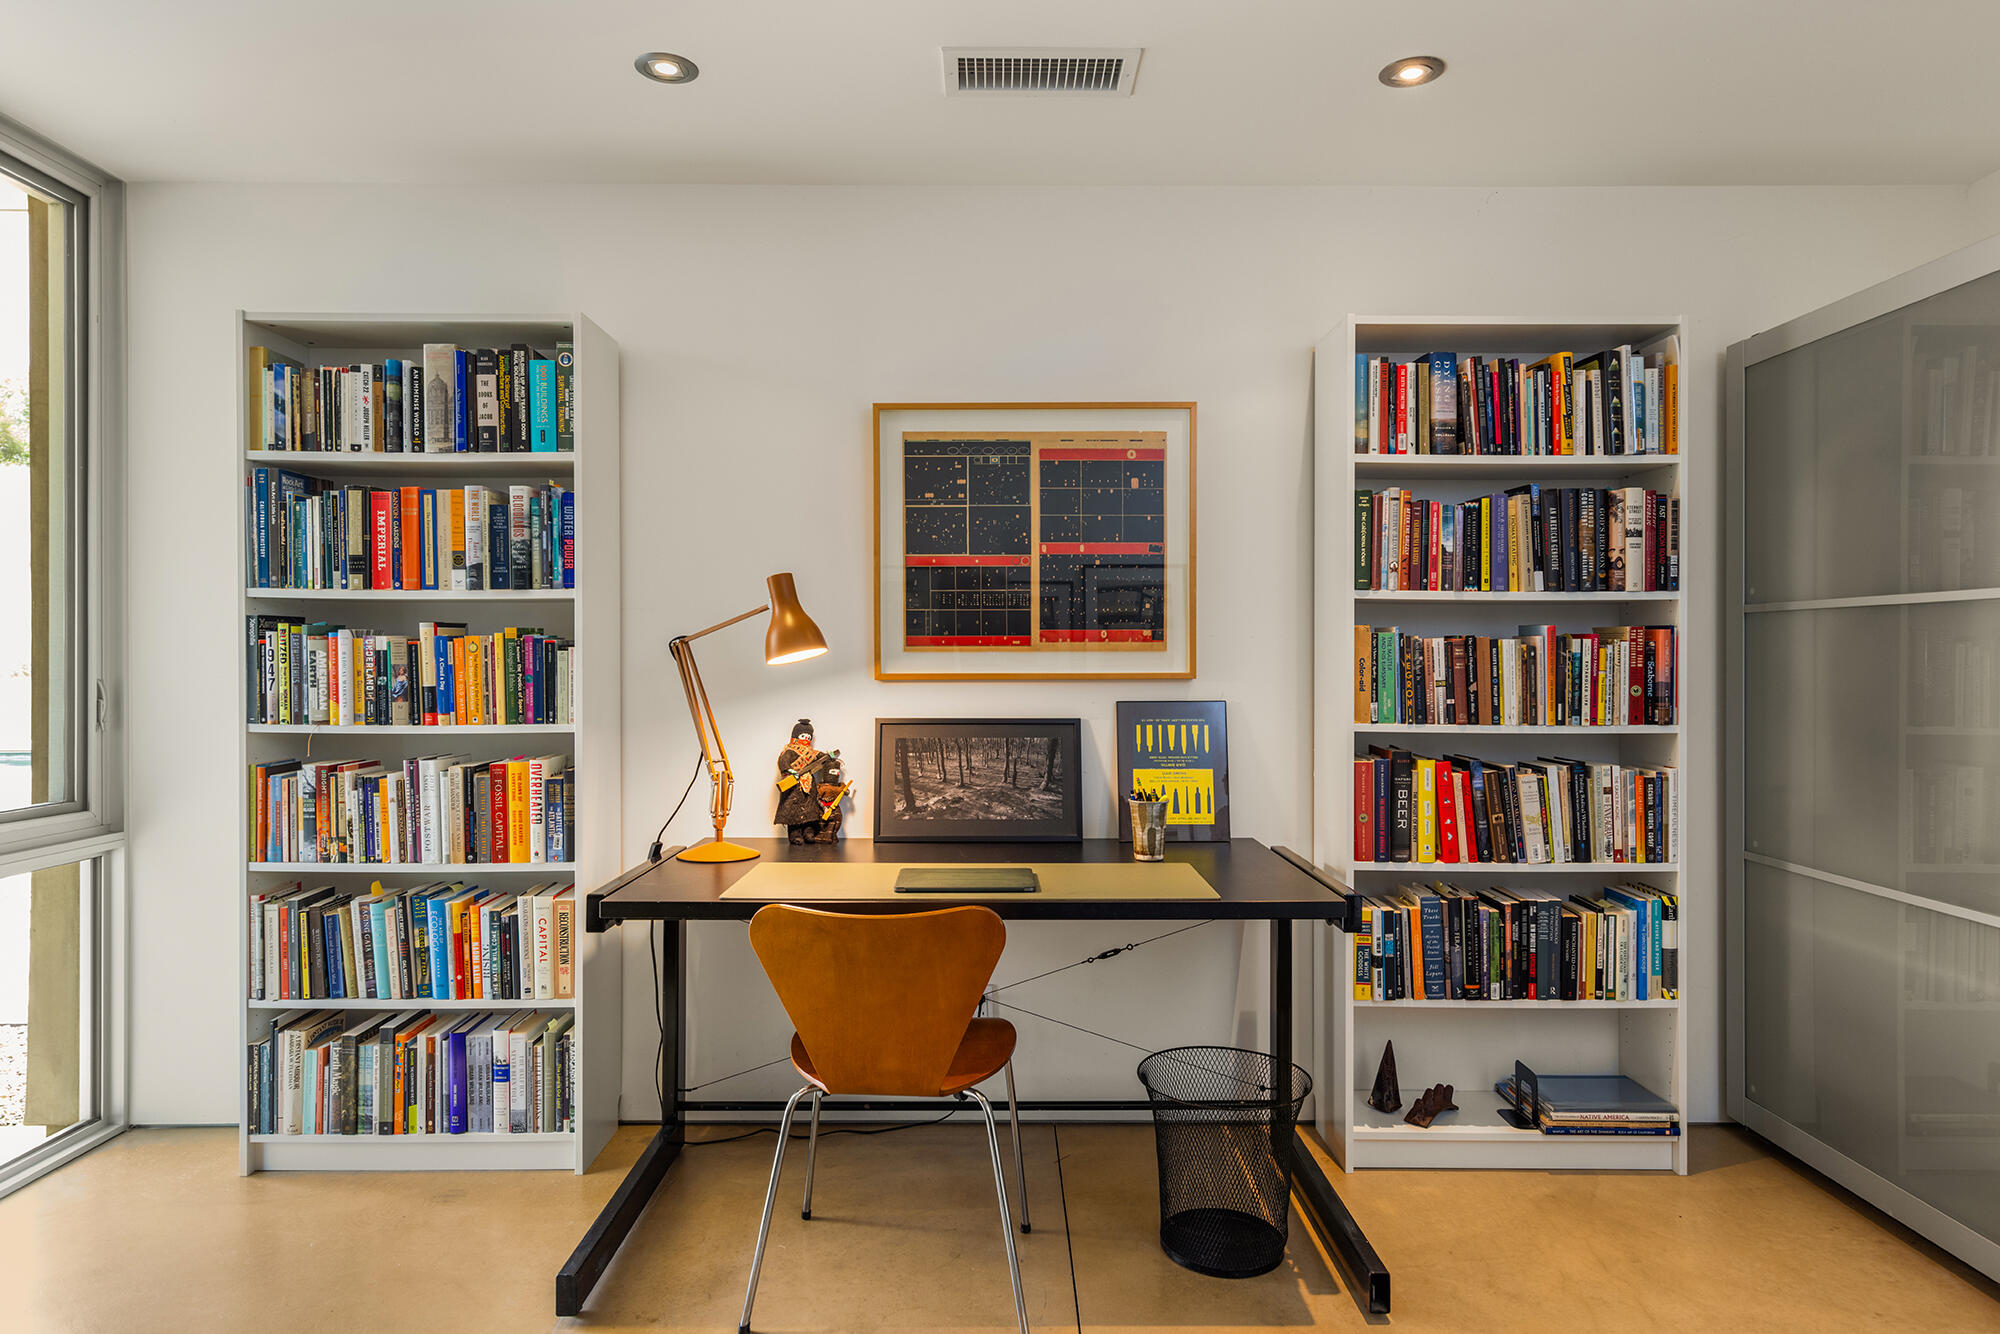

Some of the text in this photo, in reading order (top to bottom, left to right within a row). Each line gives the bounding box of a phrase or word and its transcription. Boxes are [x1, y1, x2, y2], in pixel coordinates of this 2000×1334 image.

[414, 370, 420, 379] AN
[513, 495, 524, 537] BLOODLANDS
[564, 506, 573, 569] WATER POWER
[377, 510, 386, 570] IMPERIAL
[318, 650, 327, 710] AMERICAN
[531, 764, 542, 824] OVERHEATED
[1397, 790, 1408, 828] BEER
[362, 905, 370, 932] FACING
[431, 911, 439, 951] ECOLOGY
[472, 914, 478, 923] ON
[539, 918, 547, 963] CAPITAL
[559, 912, 569, 964] RECONSTRUCTION
[331, 1047, 342, 1096] Earth Magic
